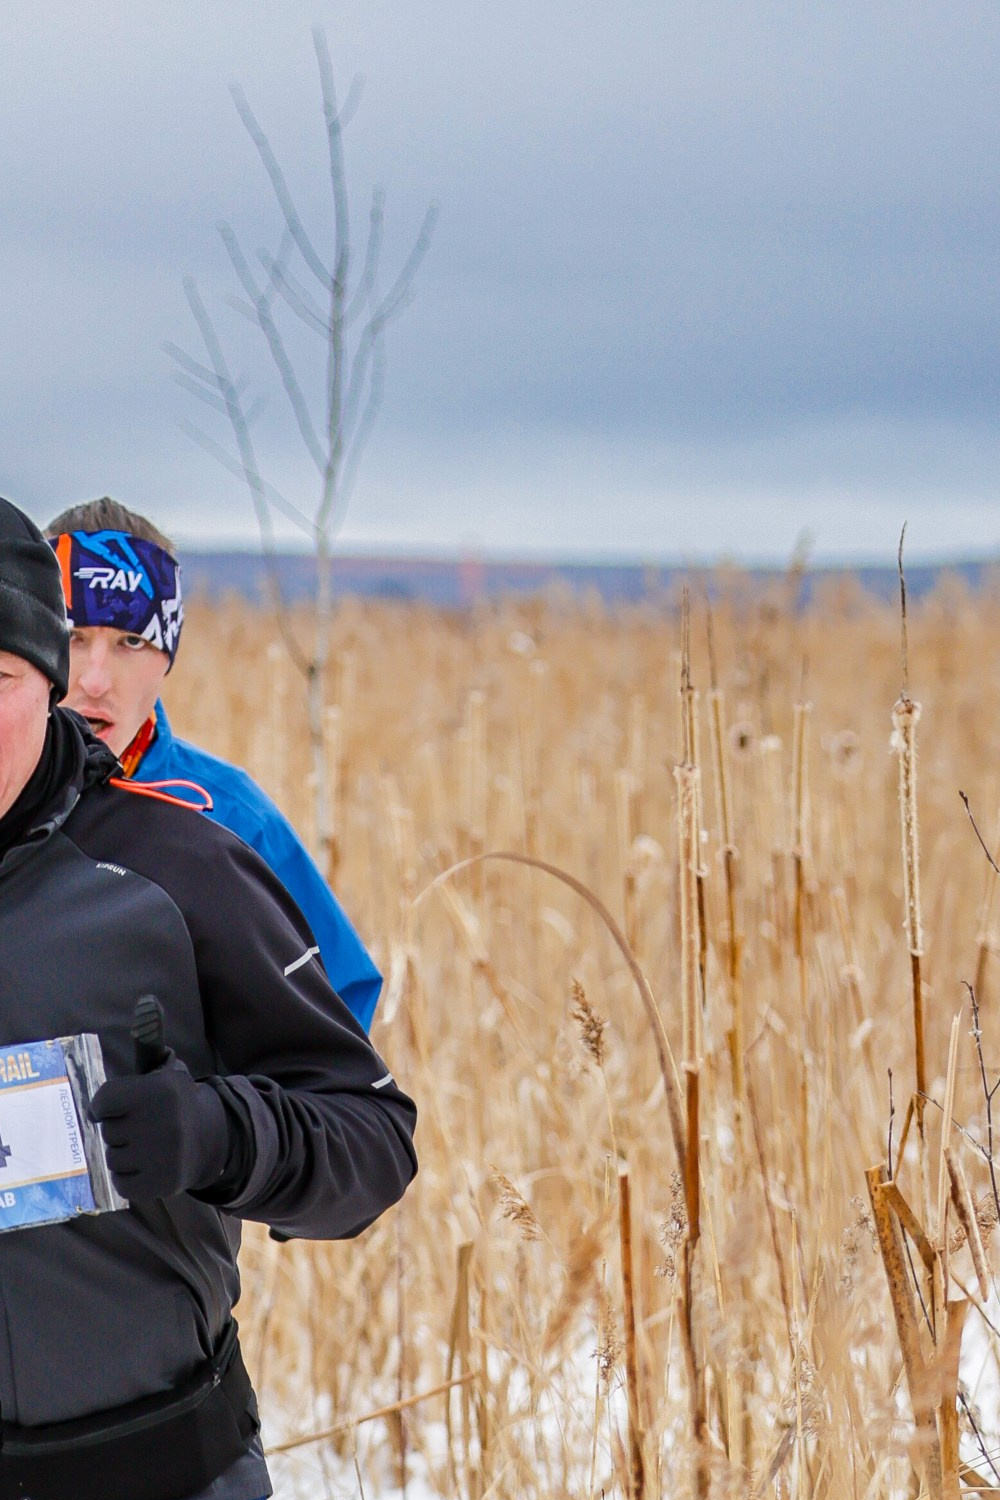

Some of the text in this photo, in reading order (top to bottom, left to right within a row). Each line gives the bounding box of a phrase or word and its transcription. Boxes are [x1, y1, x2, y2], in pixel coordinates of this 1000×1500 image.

[74, 567, 142, 592] RAY
[96, 862, 126, 876] KIPRUN
[59, 1088, 76, 1129] ЛЕСНОЙ
